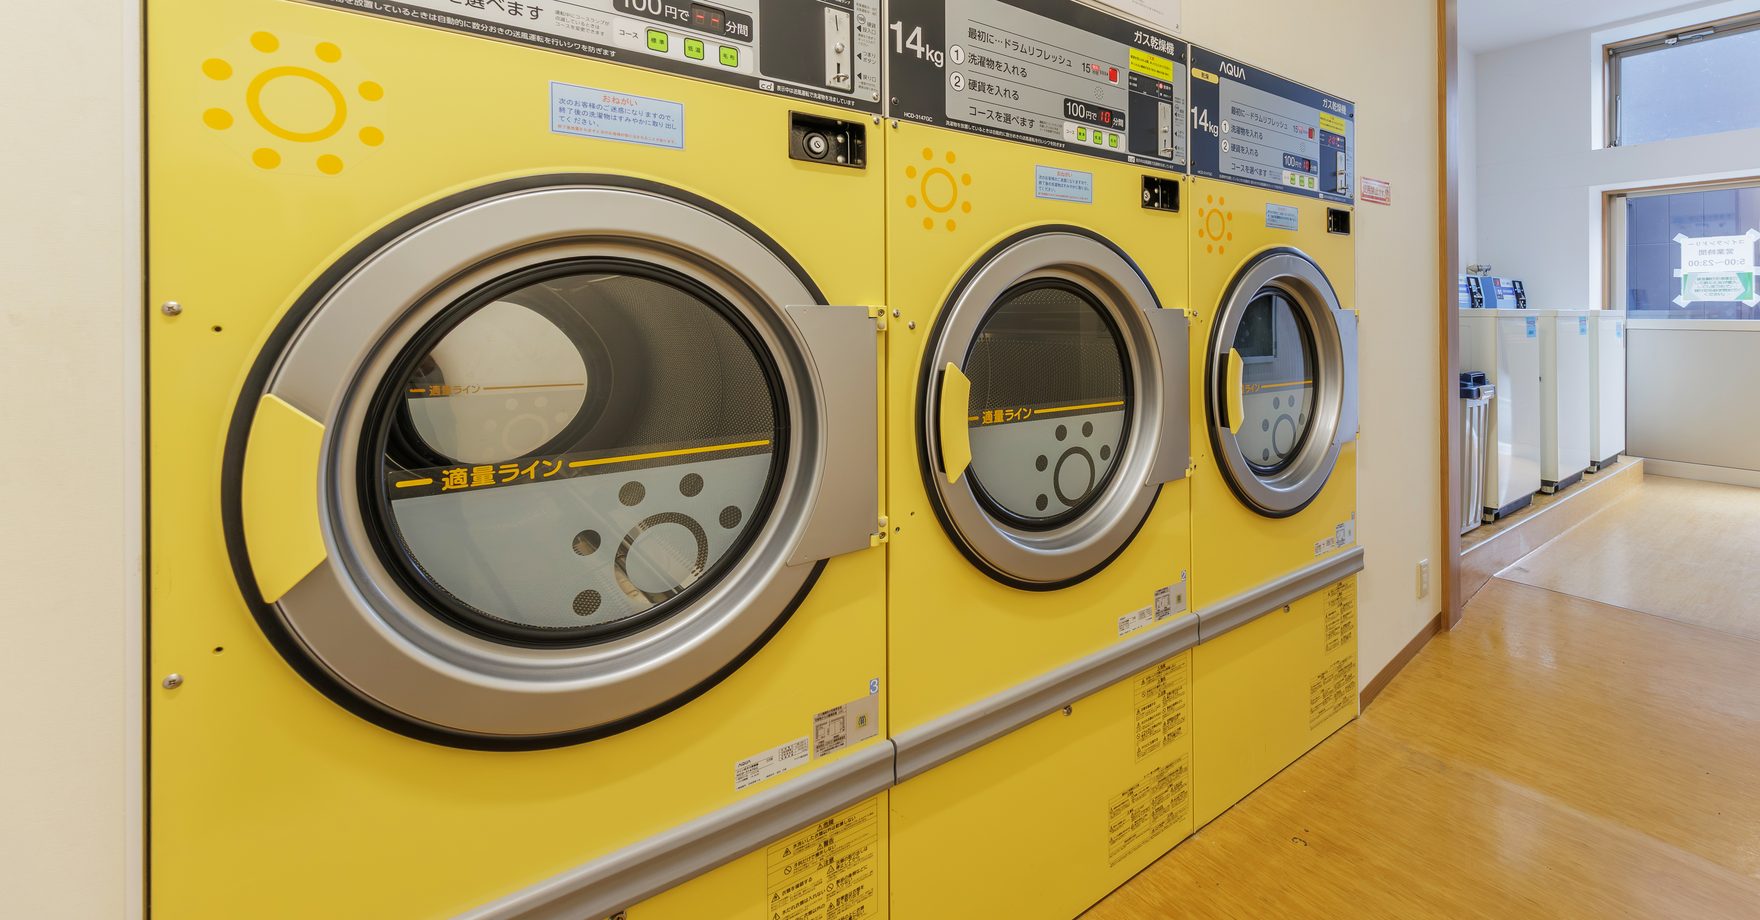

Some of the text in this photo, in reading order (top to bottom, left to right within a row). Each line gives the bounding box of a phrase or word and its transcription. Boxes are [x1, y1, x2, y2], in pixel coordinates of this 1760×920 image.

[450, 0, 543, 20] 選べます
[619, 29, 639, 39] コース
[725, 20, 749, 37] 分間
[889, 20, 944, 68] 14kg
[1133, 30, 1175, 56] ガス乾燥機
[967, 52, 1028, 78] 洗濯物を入れる
[1081, 62, 1091, 73] 15
[1219, 61, 1246, 81] AQUA
[967, 78, 1020, 101] 硬貨を入れる
[602, 95, 638, 106] おねがい
[968, 106, 1036, 129] コースを選べます
[1190, 106, 1219, 137] 14kg
[429, 384, 480, 397] 適量ライン
[982, 407, 1032, 425] 適量ライン
[441, 460, 563, 491] 適量ライン
[870, 679, 879, 694] 3
